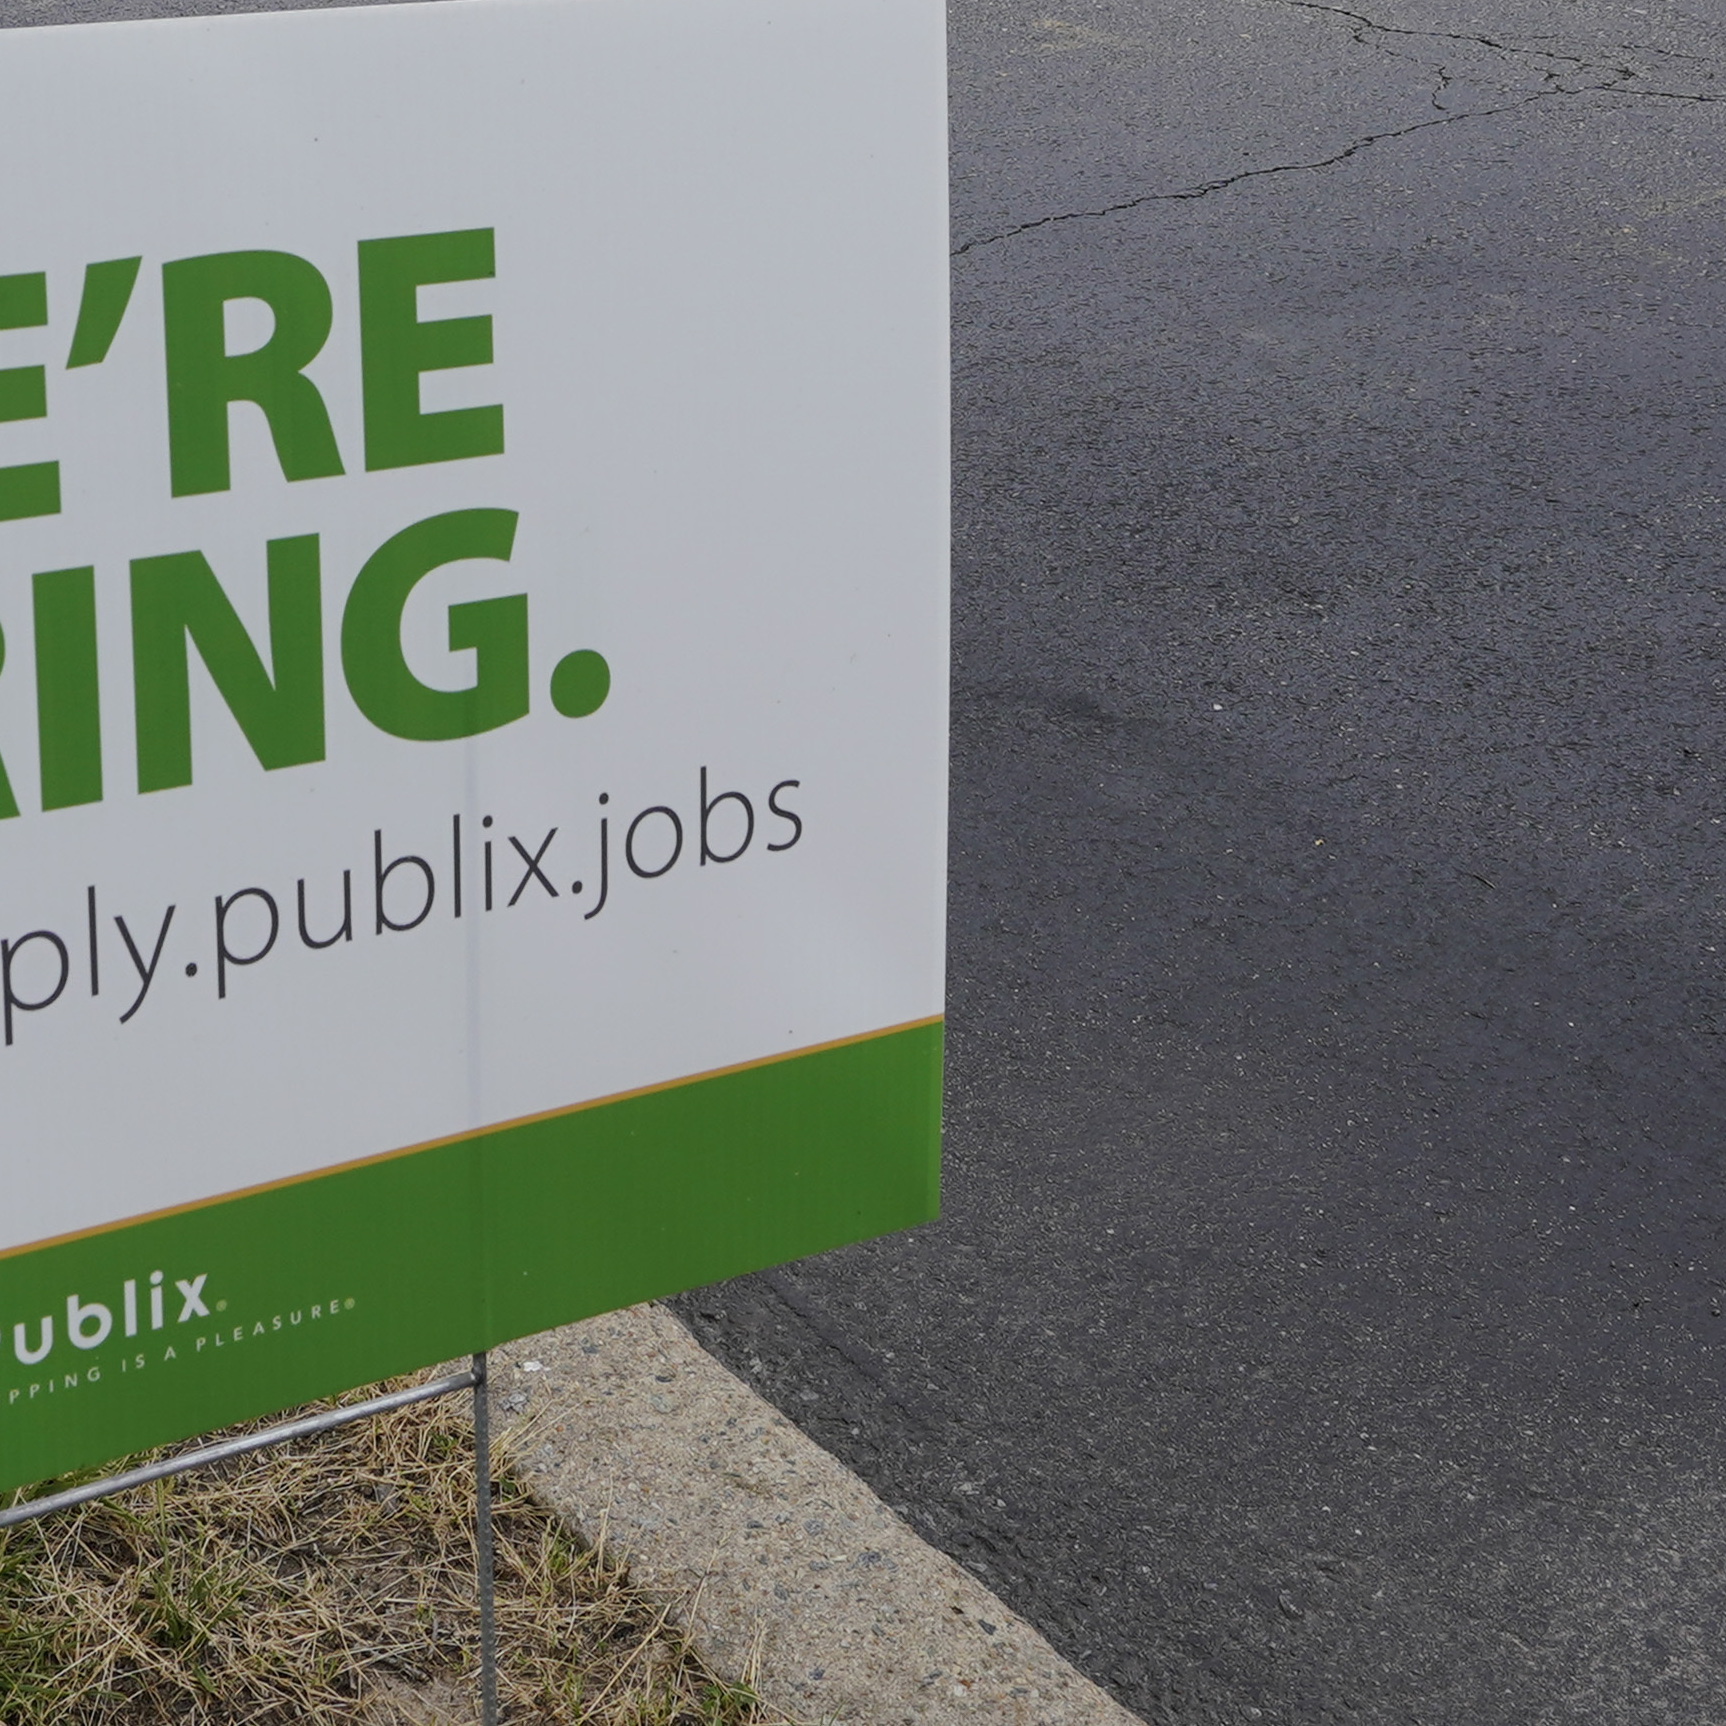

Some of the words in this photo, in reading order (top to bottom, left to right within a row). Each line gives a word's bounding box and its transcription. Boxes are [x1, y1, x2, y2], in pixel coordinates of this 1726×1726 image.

[120, 1353, 146, 1373] IS
[164, 1346, 176, 1361] A
[196, 1299, 340, 1353] PLEASURE
